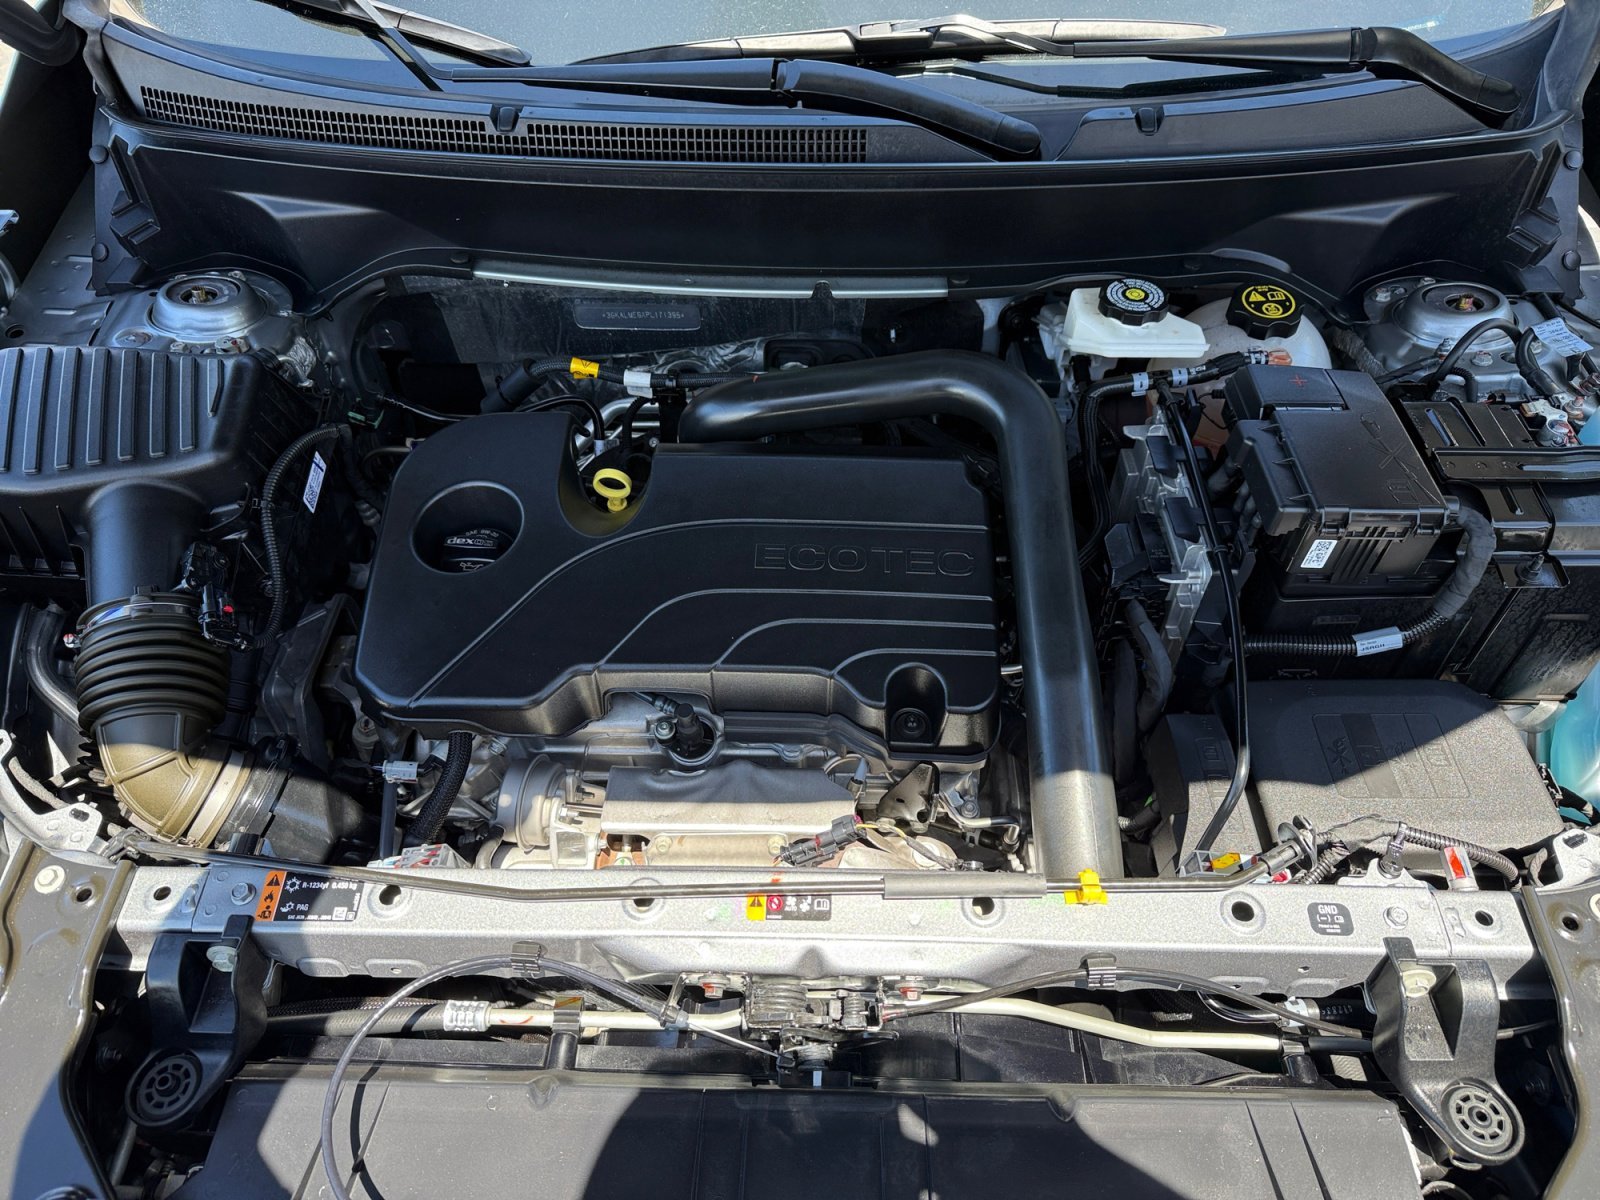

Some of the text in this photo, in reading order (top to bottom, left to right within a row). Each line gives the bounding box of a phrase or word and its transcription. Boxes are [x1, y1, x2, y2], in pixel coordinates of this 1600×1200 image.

[753, 543, 975, 577] ECOTEC
[302, 882, 328, 890] R-1234yf
[296, 903, 309, 911] PAG
[1317, 904, 1338, 915] GND
